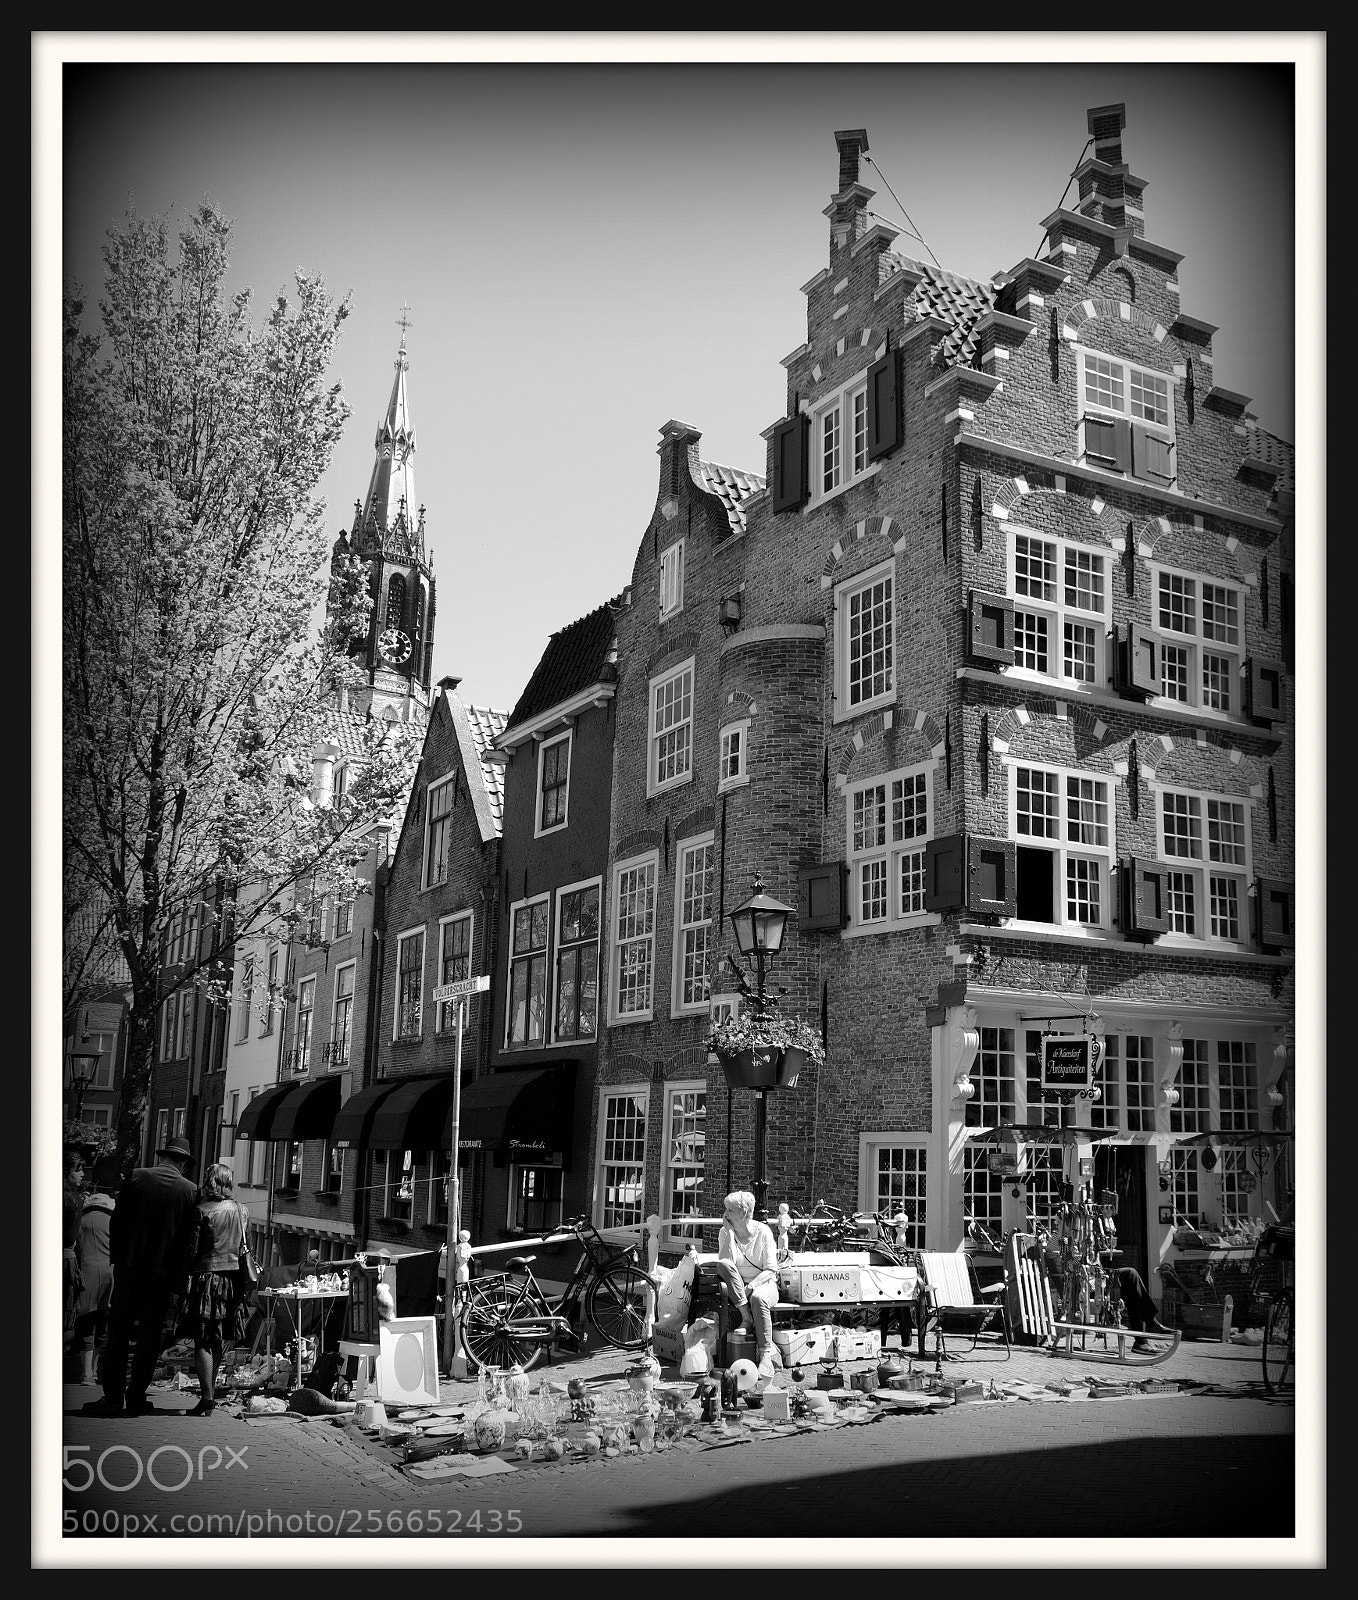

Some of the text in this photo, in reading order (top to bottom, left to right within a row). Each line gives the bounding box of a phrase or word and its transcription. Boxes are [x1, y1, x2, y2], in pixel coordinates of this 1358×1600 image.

[1047, 1059, 1086, 1078] Antiquiteiten
[812, 1273, 850, 1281] BANANAS
[655, 1328, 678, 1342] BANANAS
